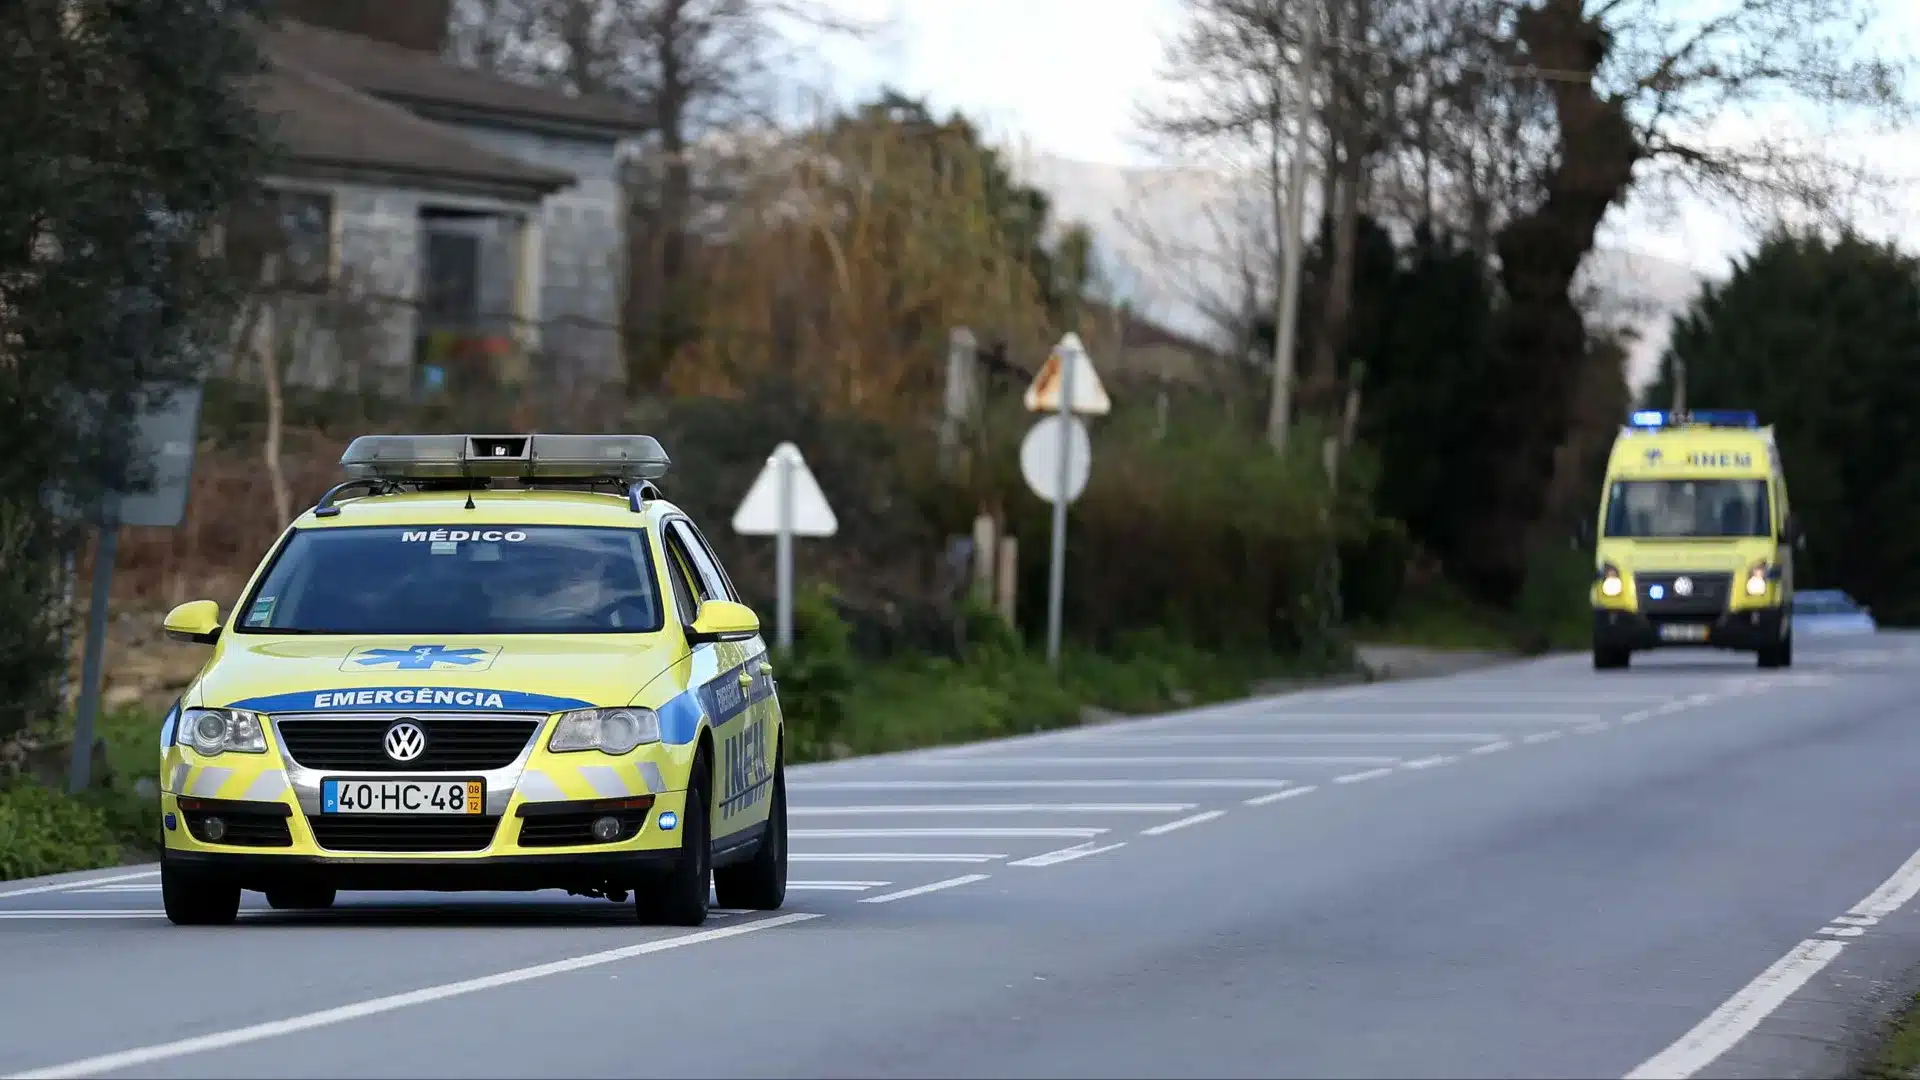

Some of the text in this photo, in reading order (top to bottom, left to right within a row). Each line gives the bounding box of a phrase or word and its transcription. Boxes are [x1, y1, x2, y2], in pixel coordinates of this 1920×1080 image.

[401, 528, 527, 542] MÉDICO
[314, 687, 504, 709] EMERGÊNCIA
[468, 785, 480, 794] 08
[327, 800, 334, 808] P
[469, 802, 479, 811] 12
